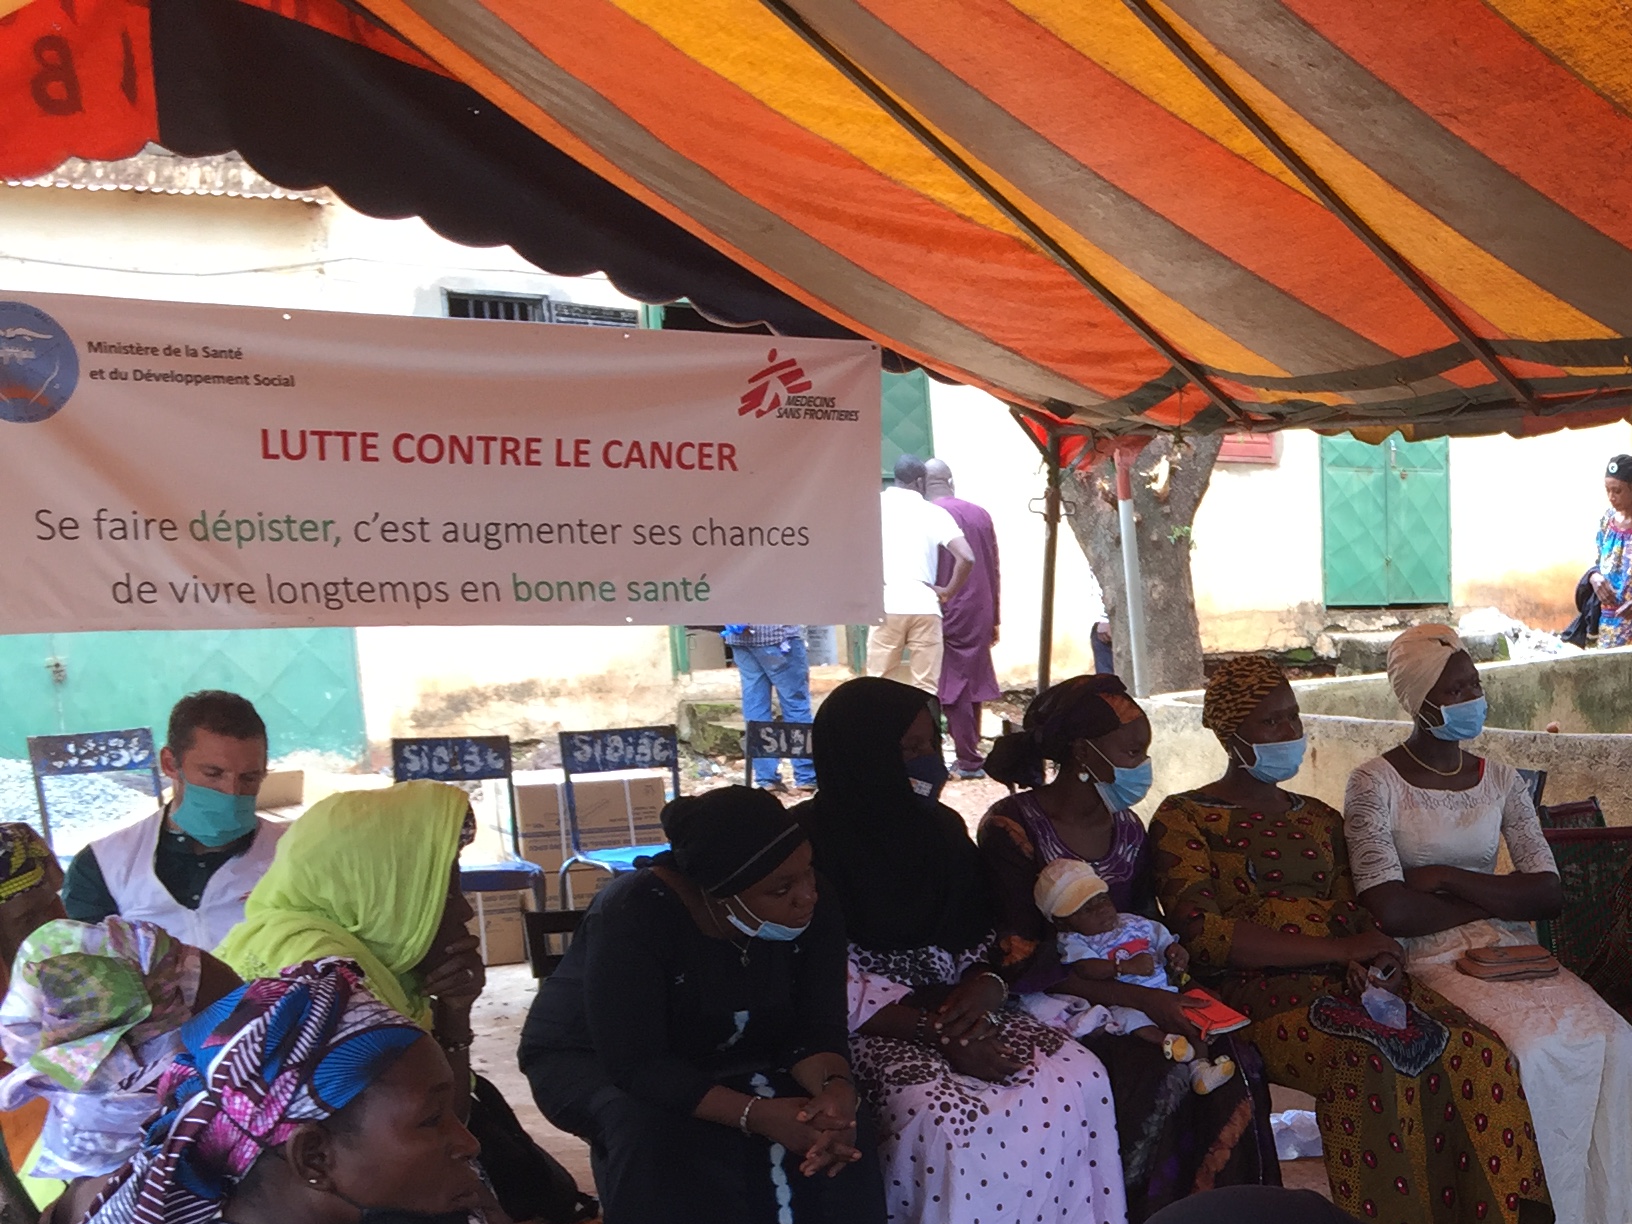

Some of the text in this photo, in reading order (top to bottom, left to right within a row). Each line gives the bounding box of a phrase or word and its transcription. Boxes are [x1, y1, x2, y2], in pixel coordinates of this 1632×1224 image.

[87, 341, 243, 360] Ministère de la Santé
[89, 368, 295, 387] et du Développement Social
[785, 396, 836, 409] MEDECINS
[776, 407, 860, 422] SANS FRONTIERES
[261, 429, 738, 471] LUTTE CONTRE LE CANCER
[35, 508, 809, 550] Se faire dépister, c'est augmenter ses chances
[112, 573, 710, 610] de vivre longtemps en bonne santé
